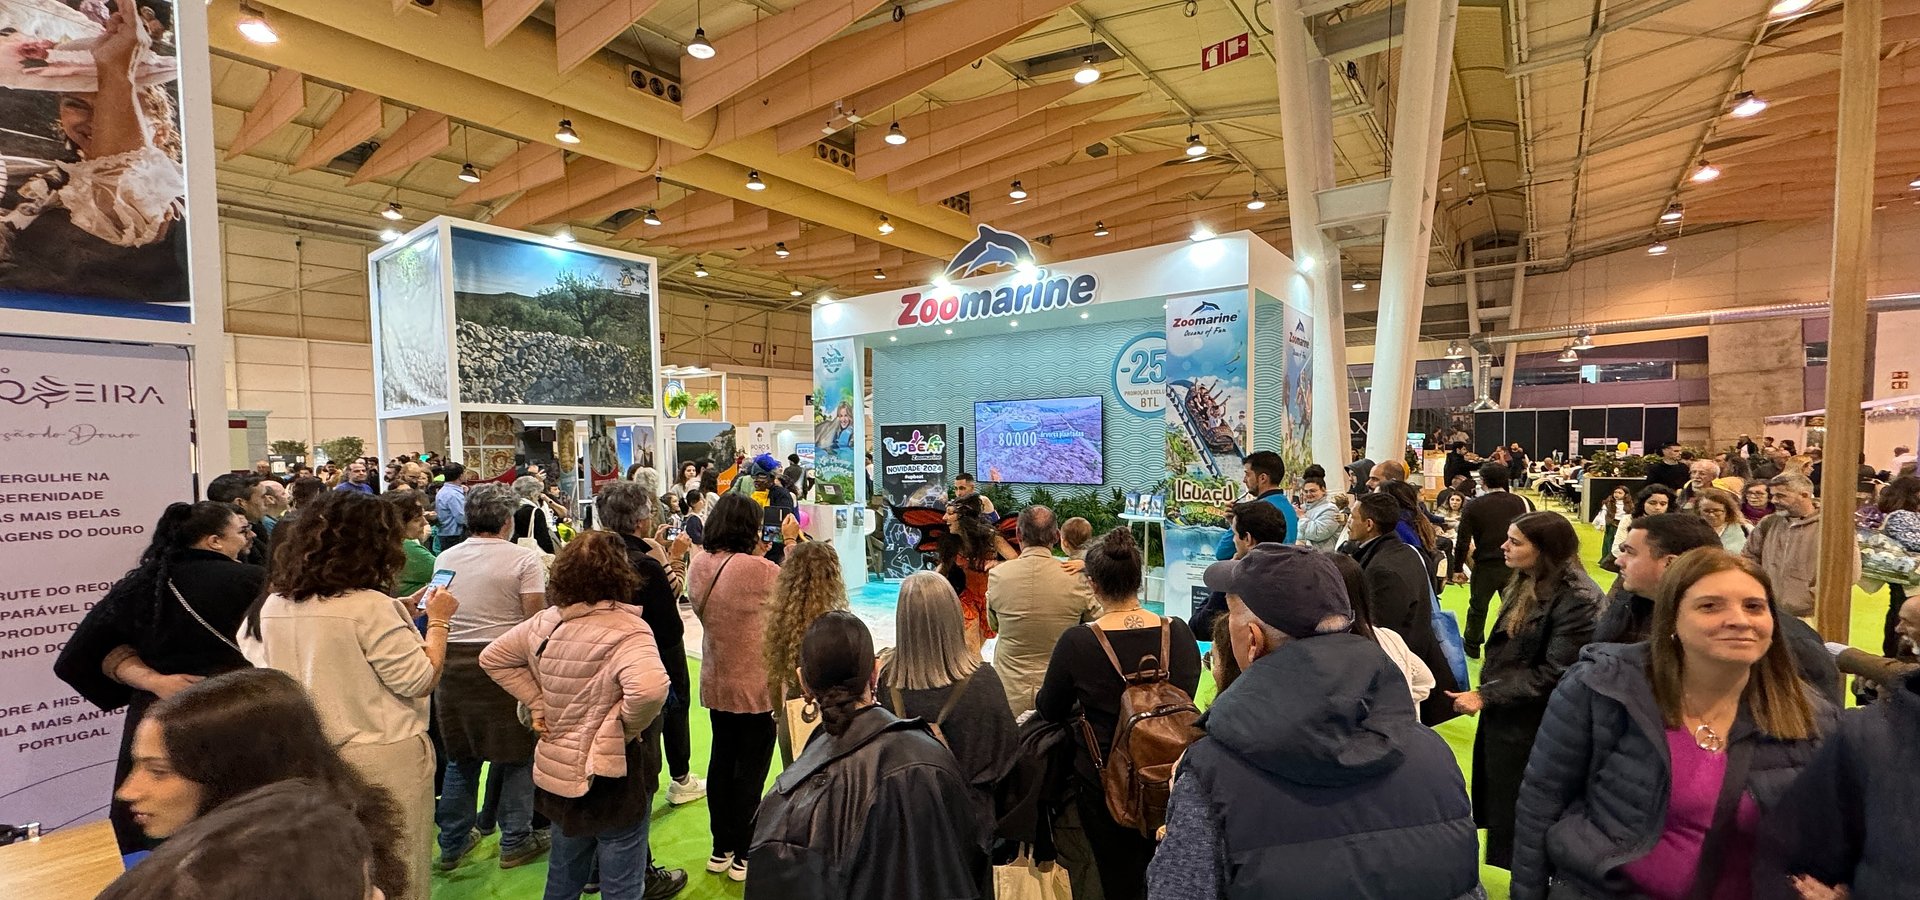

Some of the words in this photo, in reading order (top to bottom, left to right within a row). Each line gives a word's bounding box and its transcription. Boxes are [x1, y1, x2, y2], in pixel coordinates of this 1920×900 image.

[897, 269, 1097, 326] Zoomarine
[1173, 313, 1238, 328] Zoomarine
[1150, 388, 1166, 396] EXCLU
[1140, 397, 1160, 408] BTL
[999, 431, 1037, 447] 80.000
[887, 465, 921, 473] NOVIDADE
[923, 464, 942, 472] 2024
[87, 472, 110, 481] NA
[1177, 479, 1234, 506] IGUAÇU
[20, 511, 62, 522] MAIS
[67, 508, 121, 520] BELAS
[58, 528, 83, 539] DO
[87, 525, 144, 537] DOURO
[46, 585, 71, 597] DO
[76, 581, 114, 593] REQ
[36, 702, 49, 712] A
[31, 715, 73, 731] MAIS
[77, 706, 126, 723] ANTIG
[18, 727, 111, 753] PORTUGAL
